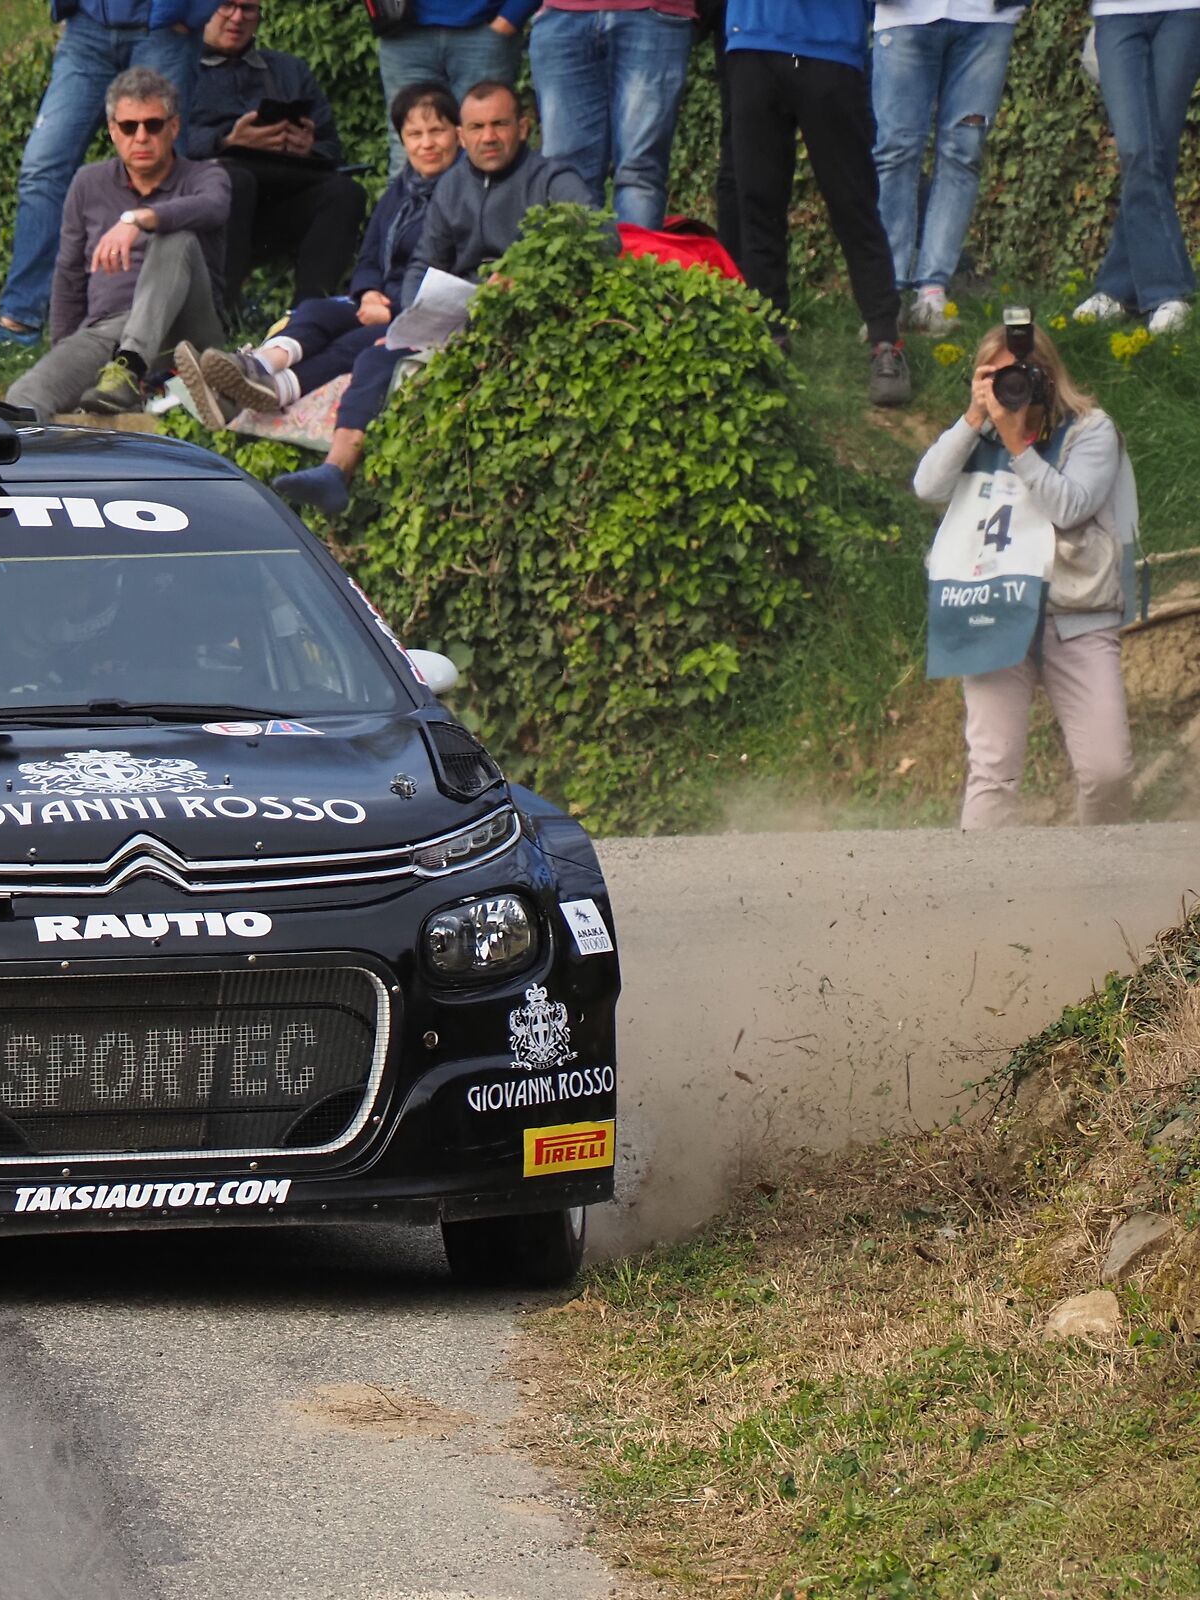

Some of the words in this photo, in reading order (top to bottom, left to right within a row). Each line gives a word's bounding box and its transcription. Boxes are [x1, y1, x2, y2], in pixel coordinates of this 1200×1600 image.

[940, 584, 990, 607] PHOTO
[1002, 580, 1026, 603] TV
[177, 796, 367, 825] ROSSO
[33, 910, 273, 943] RAUTIO
[577, 927, 604, 938] ANAIKA
[580, 936, 609, 951] WOOD
[0, 1021, 317, 1108] SPORTEC
[467, 1076, 556, 1113] GIOVANNI
[558, 1065, 615, 1100] ROSSO
[534, 1129, 607, 1166] PIRELLI
[15, 1179, 292, 1213] TAKSIAUTOT.COM
